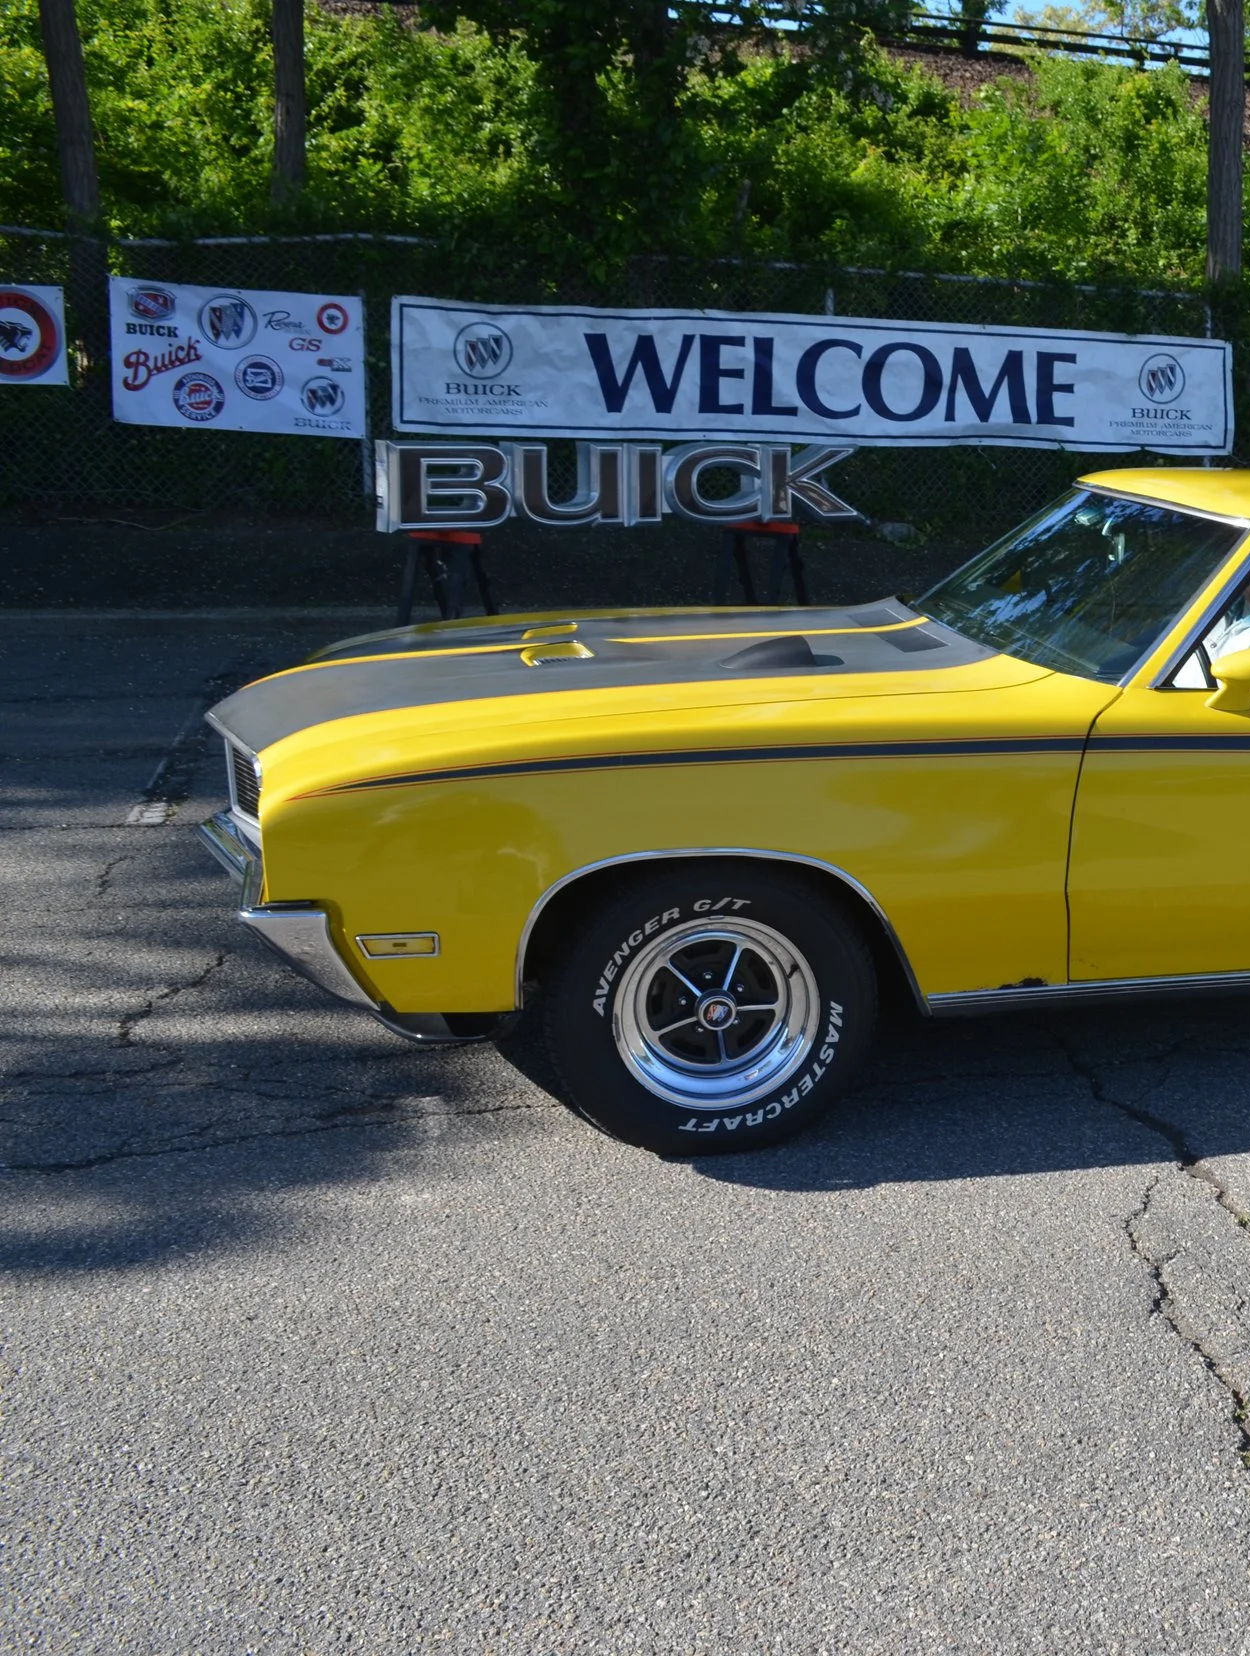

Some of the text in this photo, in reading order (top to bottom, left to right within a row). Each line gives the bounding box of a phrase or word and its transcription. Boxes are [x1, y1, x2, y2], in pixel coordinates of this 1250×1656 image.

[125, 322, 179, 338] BUICK
[288, 337, 322, 352] GS
[122, 337, 202, 392] Buick
[583, 333, 1077, 427] WELCOME
[445, 382, 521, 396] BUICK
[418, 396, 549, 408] PREMIUM AMERICAN
[444, 407, 523, 416] MOTORCARS
[1131, 408, 1192, 420] BUICK
[293, 417, 352, 431] BUICK
[1109, 421, 1213, 431] PREMIUM AMERICAN
[1130, 429, 1192, 437] MOTORCARS
[375, 440, 870, 532] BUICK
[592, 897, 752, 1017] AVENGER G/T
[678, 1000, 844, 1132] MASTERCRAFT
